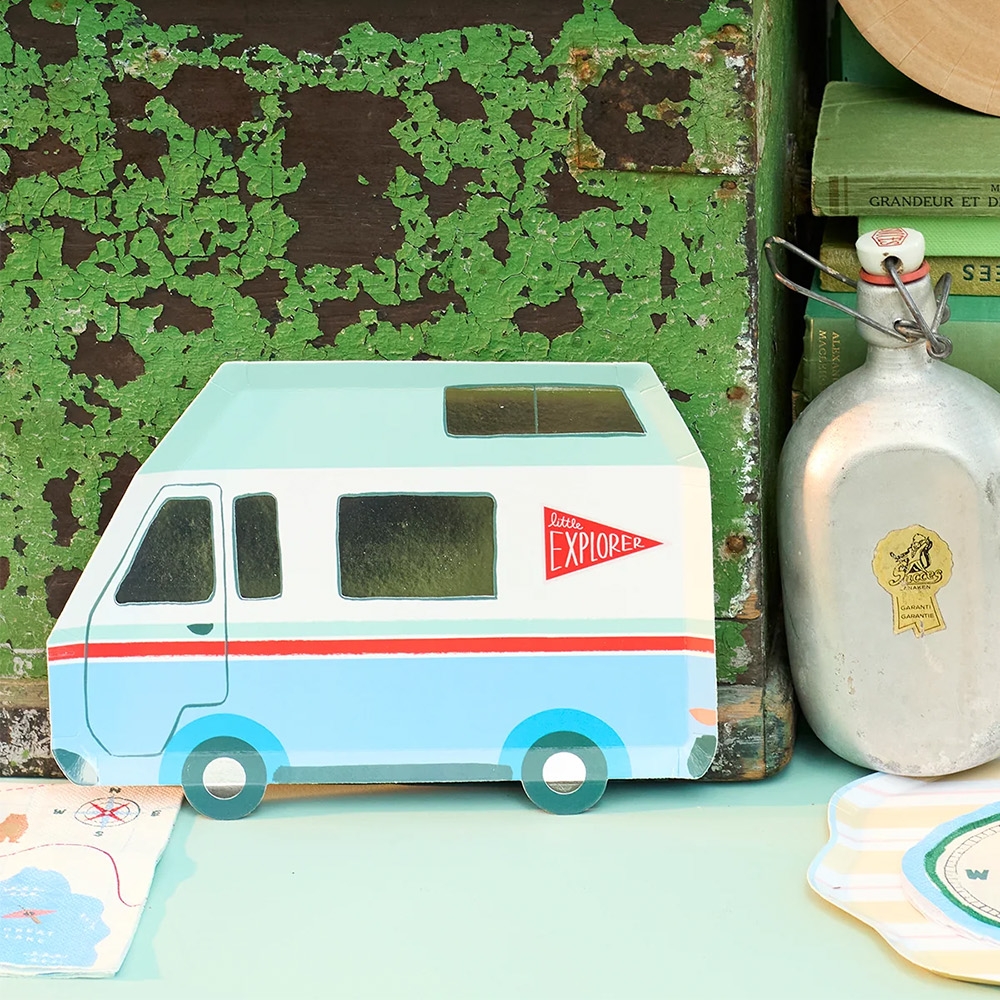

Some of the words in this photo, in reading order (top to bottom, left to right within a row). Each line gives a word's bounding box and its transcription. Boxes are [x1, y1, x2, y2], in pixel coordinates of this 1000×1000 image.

[869, 195, 954, 208] GRANDEUR
[961, 196, 980, 208] ET
[548, 512, 583, 530] little
[549, 530, 645, 571] EXPLORER
[965, 869, 989, 880] W
